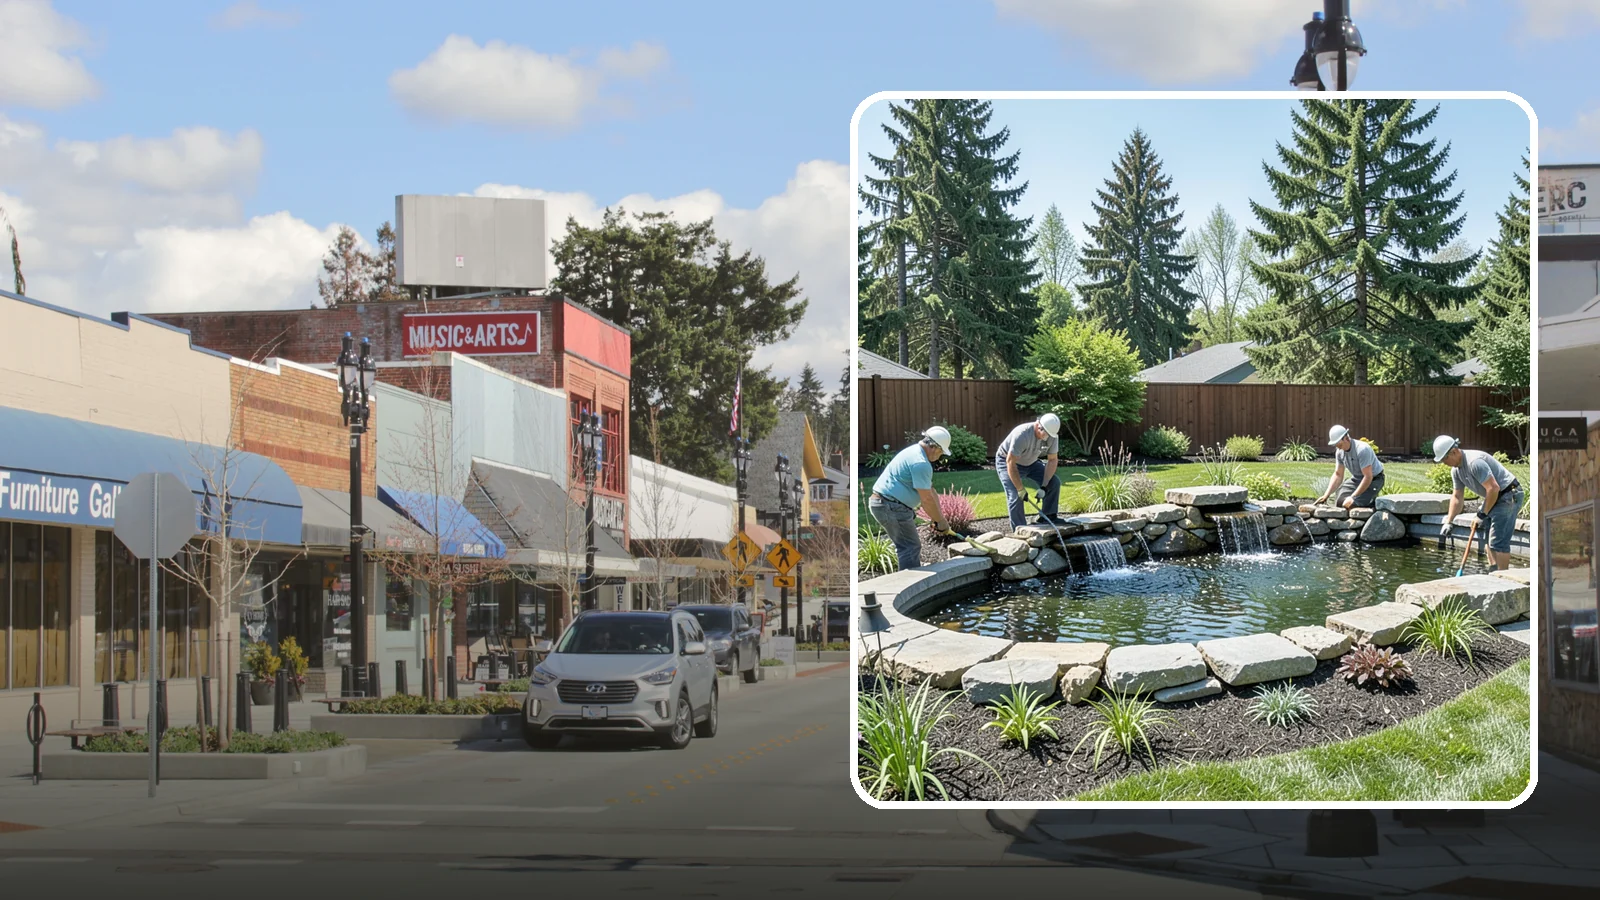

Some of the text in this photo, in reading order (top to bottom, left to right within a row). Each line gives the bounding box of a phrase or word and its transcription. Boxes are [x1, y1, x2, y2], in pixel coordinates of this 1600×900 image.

[408, 323, 519, 348] MUSIC&ARTS
[0, 471, 79, 515] Furniture
[453, 563, 479, 574] SUSHI
